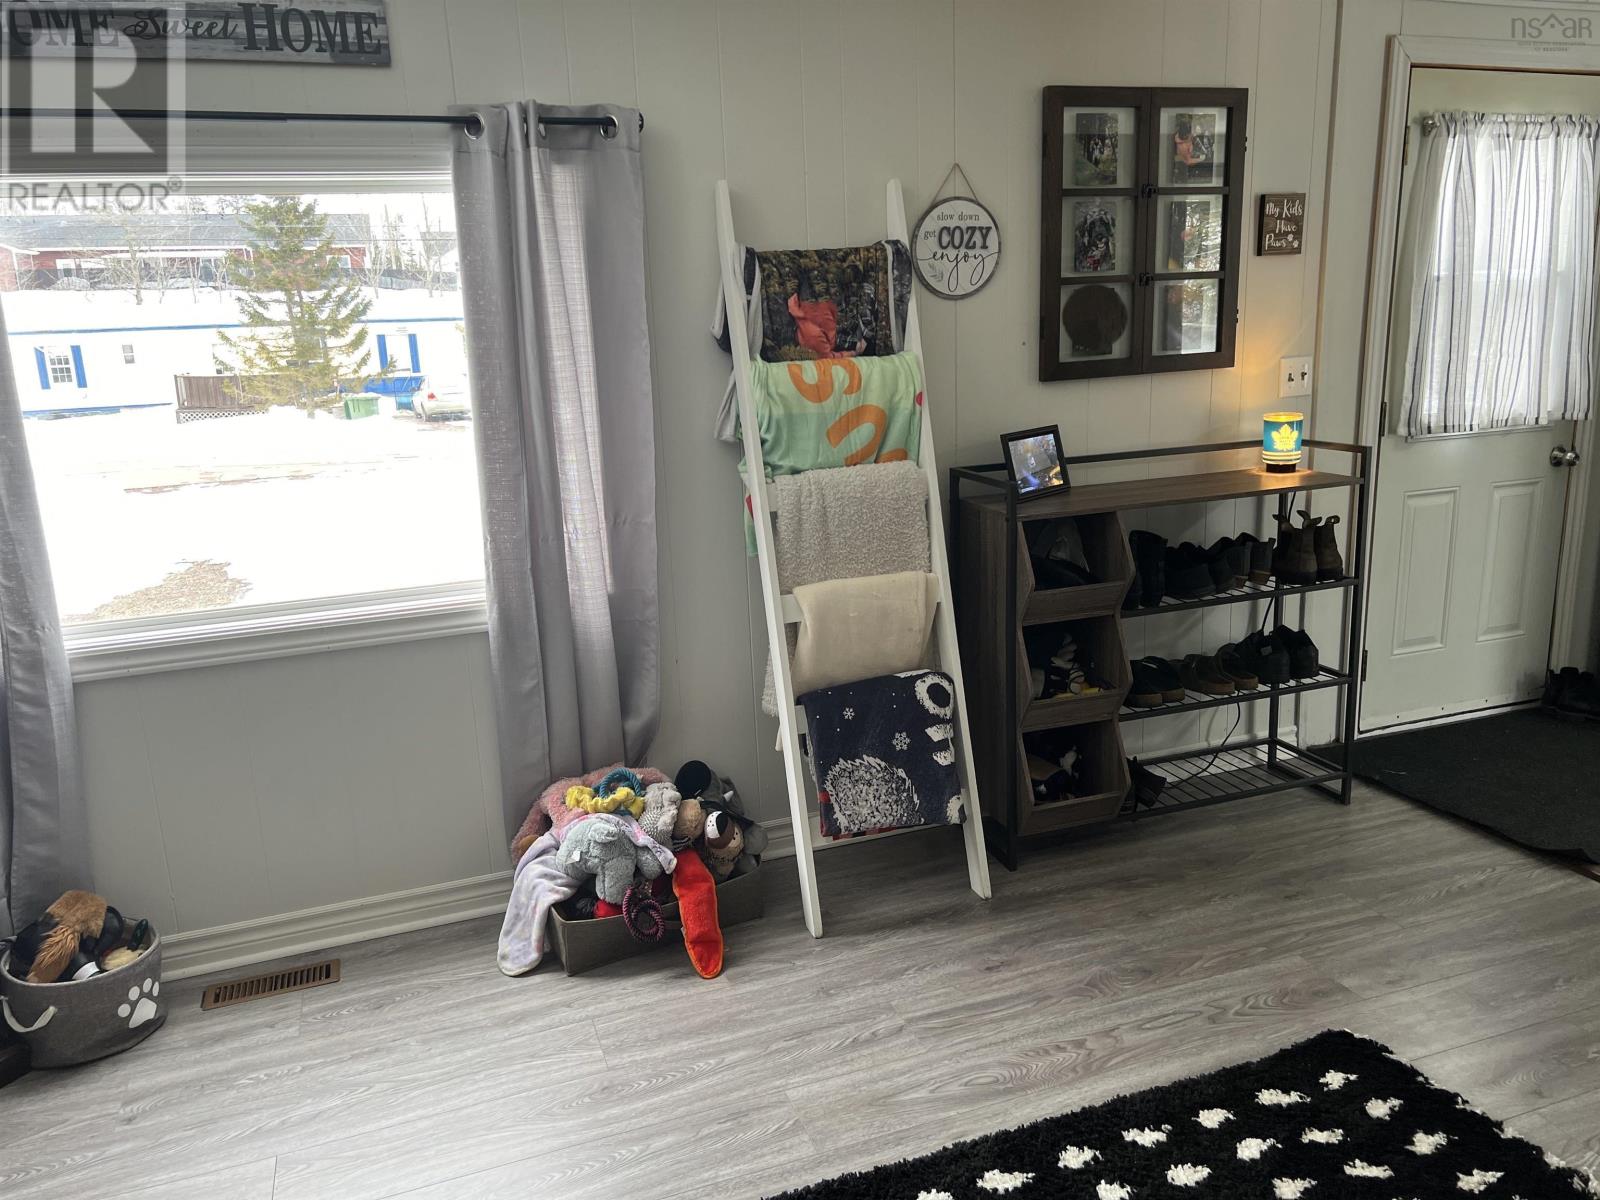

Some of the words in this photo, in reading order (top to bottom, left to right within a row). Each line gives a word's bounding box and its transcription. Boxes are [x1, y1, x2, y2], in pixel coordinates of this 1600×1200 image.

[7, 0, 119, 47] OME
[123, 8, 238, 40] Sweet
[237, 2, 381, 55] HOME
[936, 212, 955, 220] slow
[958, 211, 980, 221] down
[1265, 203, 1280, 217] My
[1282, 199, 1303, 218] Kids
[1275, 220, 1280, 233] I
[923, 230, 936, 240] get
[938, 226, 992, 250] COZY
[1265, 234, 1287, 251] Paws
[930, 250, 986, 292] enjoy
